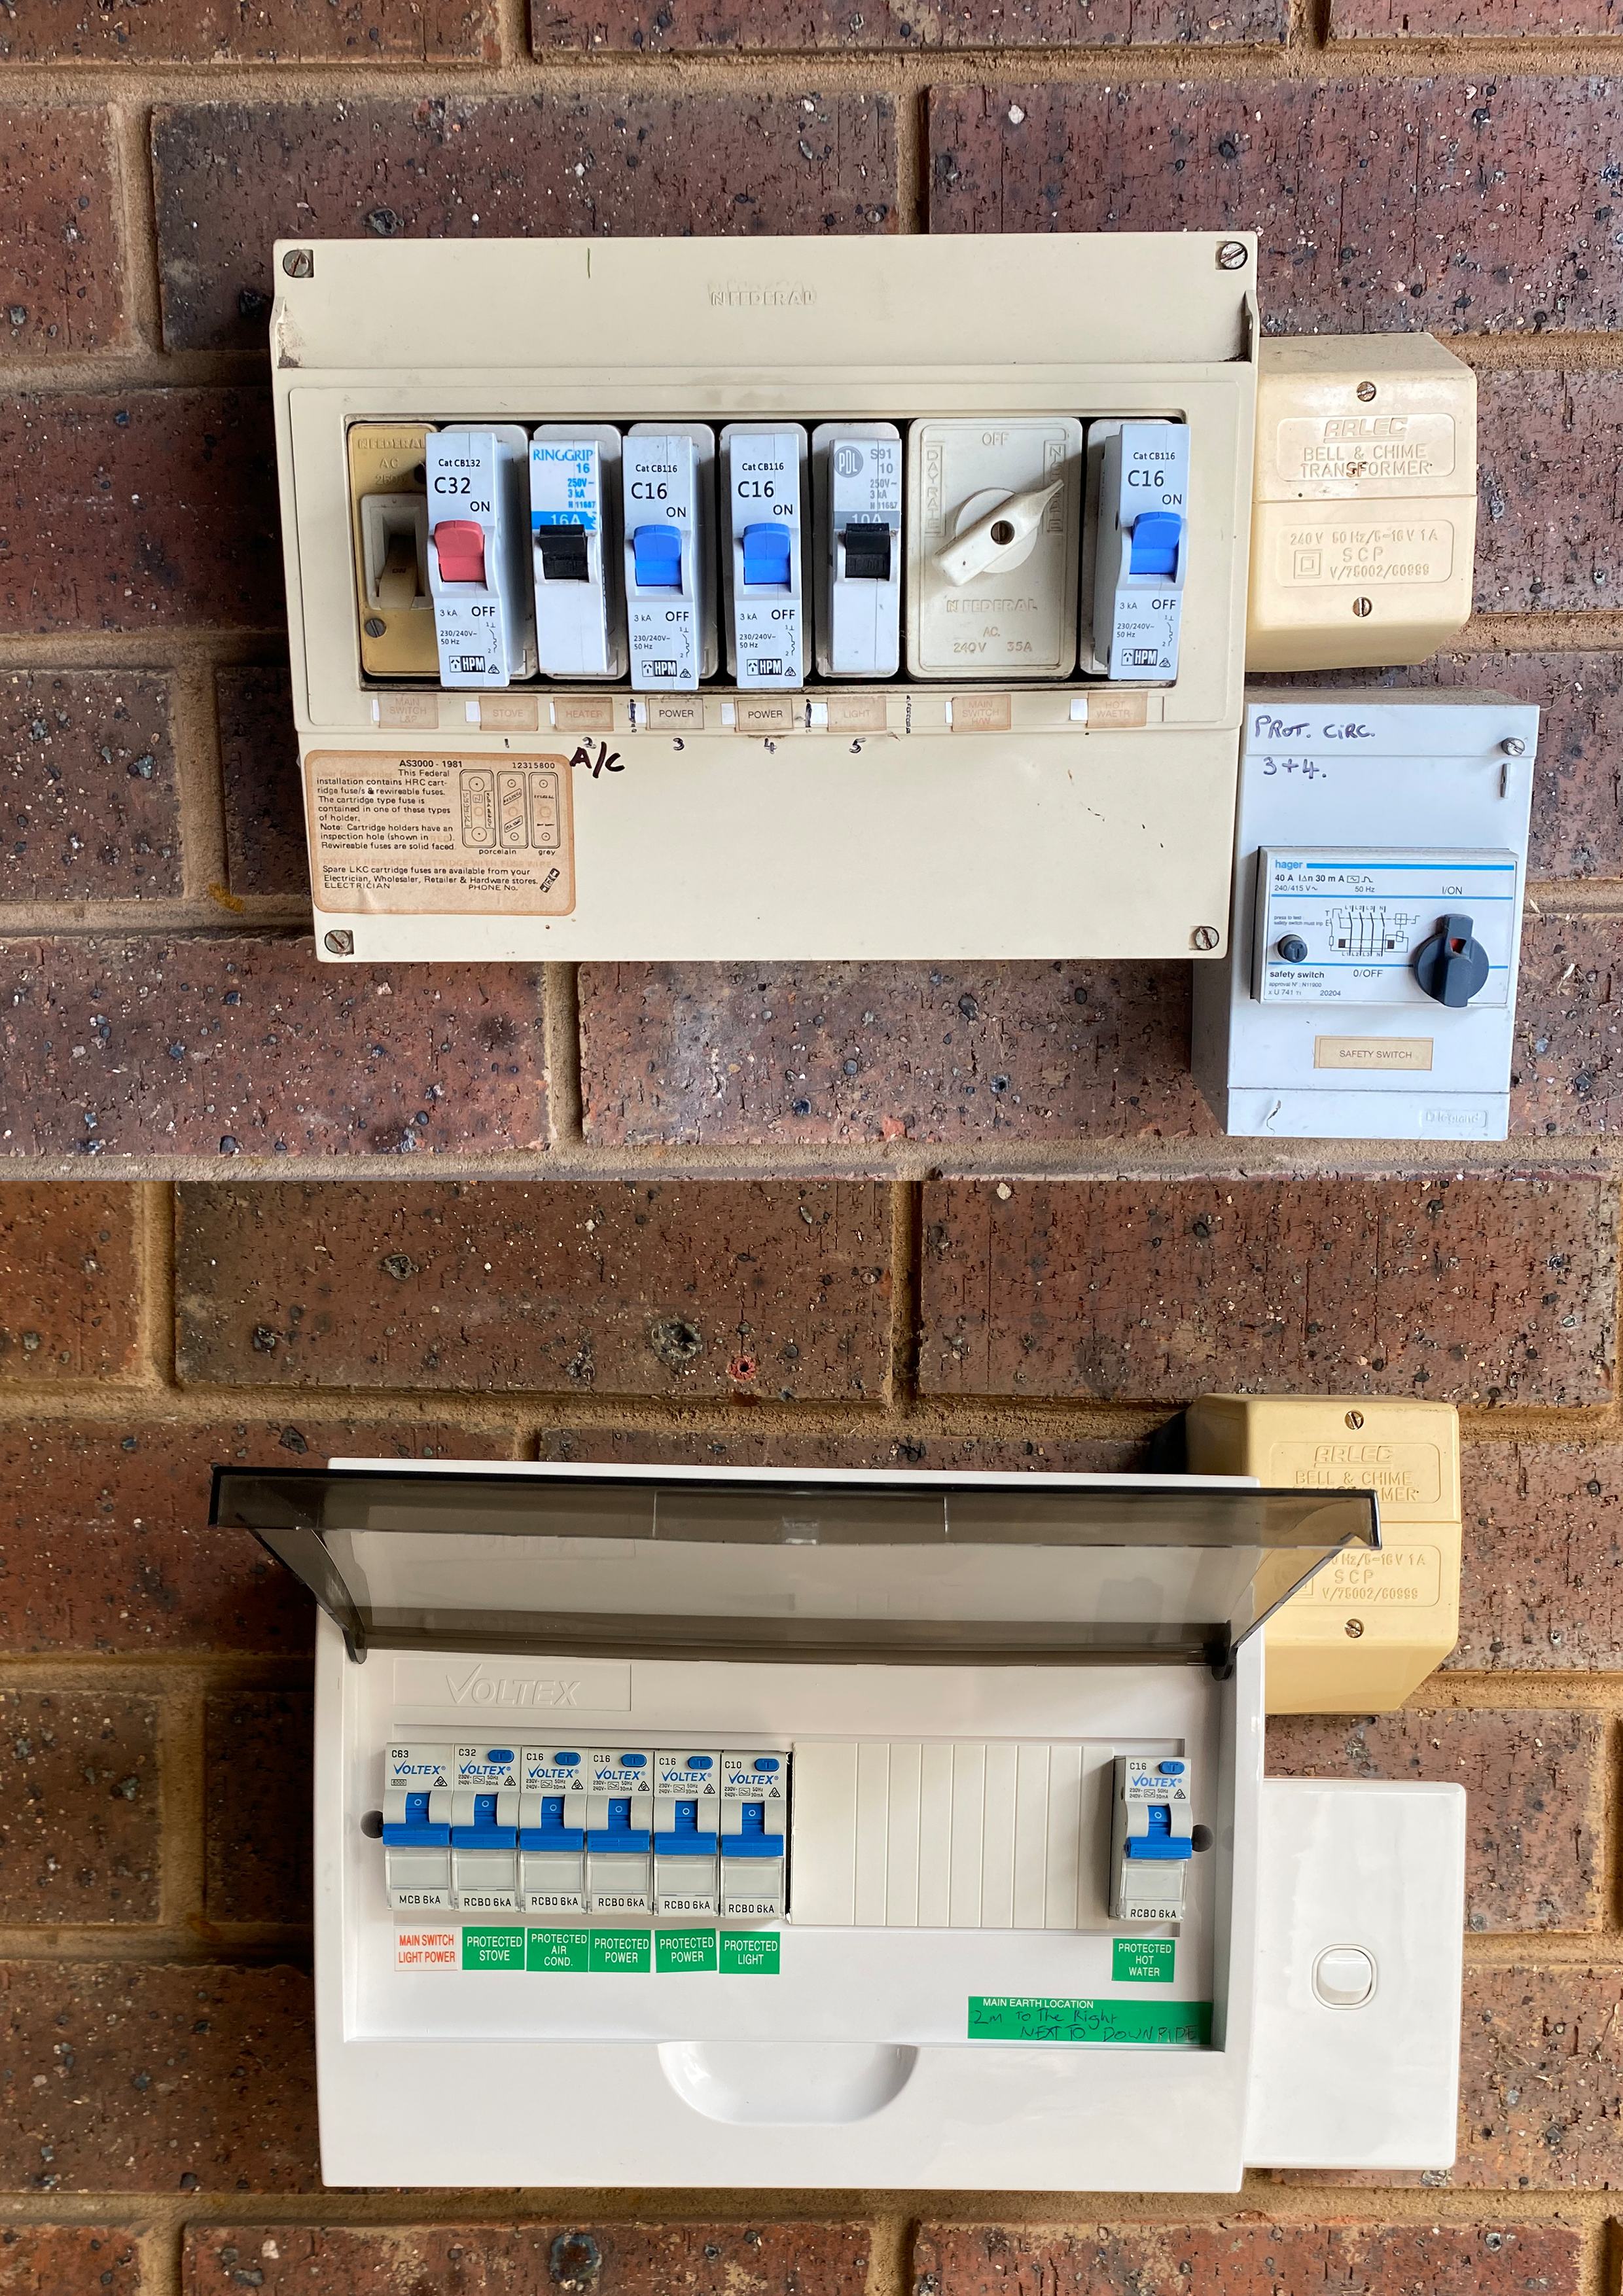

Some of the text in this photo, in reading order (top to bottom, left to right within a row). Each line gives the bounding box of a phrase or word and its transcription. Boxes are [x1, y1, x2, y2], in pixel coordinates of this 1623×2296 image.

[1325, 417, 1408, 437] ARLEC
[982, 432, 1009, 446] OFF
[533, 449, 593, 461] RINGGRIP
[870, 449, 892, 459] S91
[1304, 444, 1426, 461] BELL CHIME
[577, 463, 590, 473] 16
[880, 463, 893, 473] 10
[1301, 461, 1429, 478] TRANSFORMER
[1128, 470, 1164, 487] C16
[434, 477, 471, 494] C32
[631, 482, 668, 499] C16
[738, 481, 774, 497] C16
[1162, 494, 1182, 505] ON
[470, 501, 490, 512] ON
[666, 507, 687, 517] ON
[773, 505, 793, 515] ON
[1152, 600, 1176, 610] OFF
[471, 606, 495, 617] OFF
[666, 611, 689, 622] OFF
[771, 609, 795, 620] OFF
[1135, 650, 1157, 664] HPM
[462, 657, 484, 672] HPM
[654, 661, 677, 676] HPM
[759, 660, 781, 675] HPM
[493, 709, 524, 717] STOVE
[748, 710, 783, 719] POWER
[844, 709, 870, 718] LIGHT
[673, 738, 685, 751] 3
[764, 738, 778, 755] 4
[849, 738, 866, 753] 5
[569, 742, 625, 778] A/C
[317, 787, 338, 796] ridge
[336, 796, 374, 804] cartridge
[1275, 859, 1303, 870] hager
[1442, 886, 1463, 895] I/ON
[1340, 1050, 1412, 1059] SAFETY SWITCH
[1314, 1446, 1393, 1462] ARLEC
[1296, 1471, 1412, 1485] BELL CHIME
[446, 1663, 580, 1706] VOLTEX
[399, 1895, 440, 1904] MCB 6kA
[464, 1898, 511, 1907] RCBO 6kA
[531, 1897, 579, 1906] RCBO 6kA
[664, 1901, 710, 1909] RCBO 6kA
[1130, 1909, 1176, 1918] RCBO 6kA
[399, 1934, 454, 1946] MAIN SWITCH
[467, 1936, 522, 1947] PROTECTED
[531, 1933, 587, 1944] PROTECTED
[594, 1938, 649, 1949] PROTECTED
[660, 1937, 714, 1949] PROTECTED
[551, 1945, 567, 1954] AIR
[724, 1941, 777, 1951] PROTECTED
[1118, 1943, 1171, 1953] PROTECTED
[399, 1951, 455, 1963] LIGHT POWER
[479, 1950, 510, 1961] STOVE
[605, 1952, 638, 1963] POWER
[671, 1951, 704, 1962] POWER
[738, 1954, 764, 1965] LIGHT
[1135, 1956, 1154, 1964] HOT
[544, 1957, 573, 1966] COND.
[1129, 1967, 1160, 1977] WATER
[982, 1998, 1094, 2009] MAIN EARTH LOCATION
[1073, 2010, 1118, 2030] Right
[1020, 2024, 1086, 2041] NEXT TO
